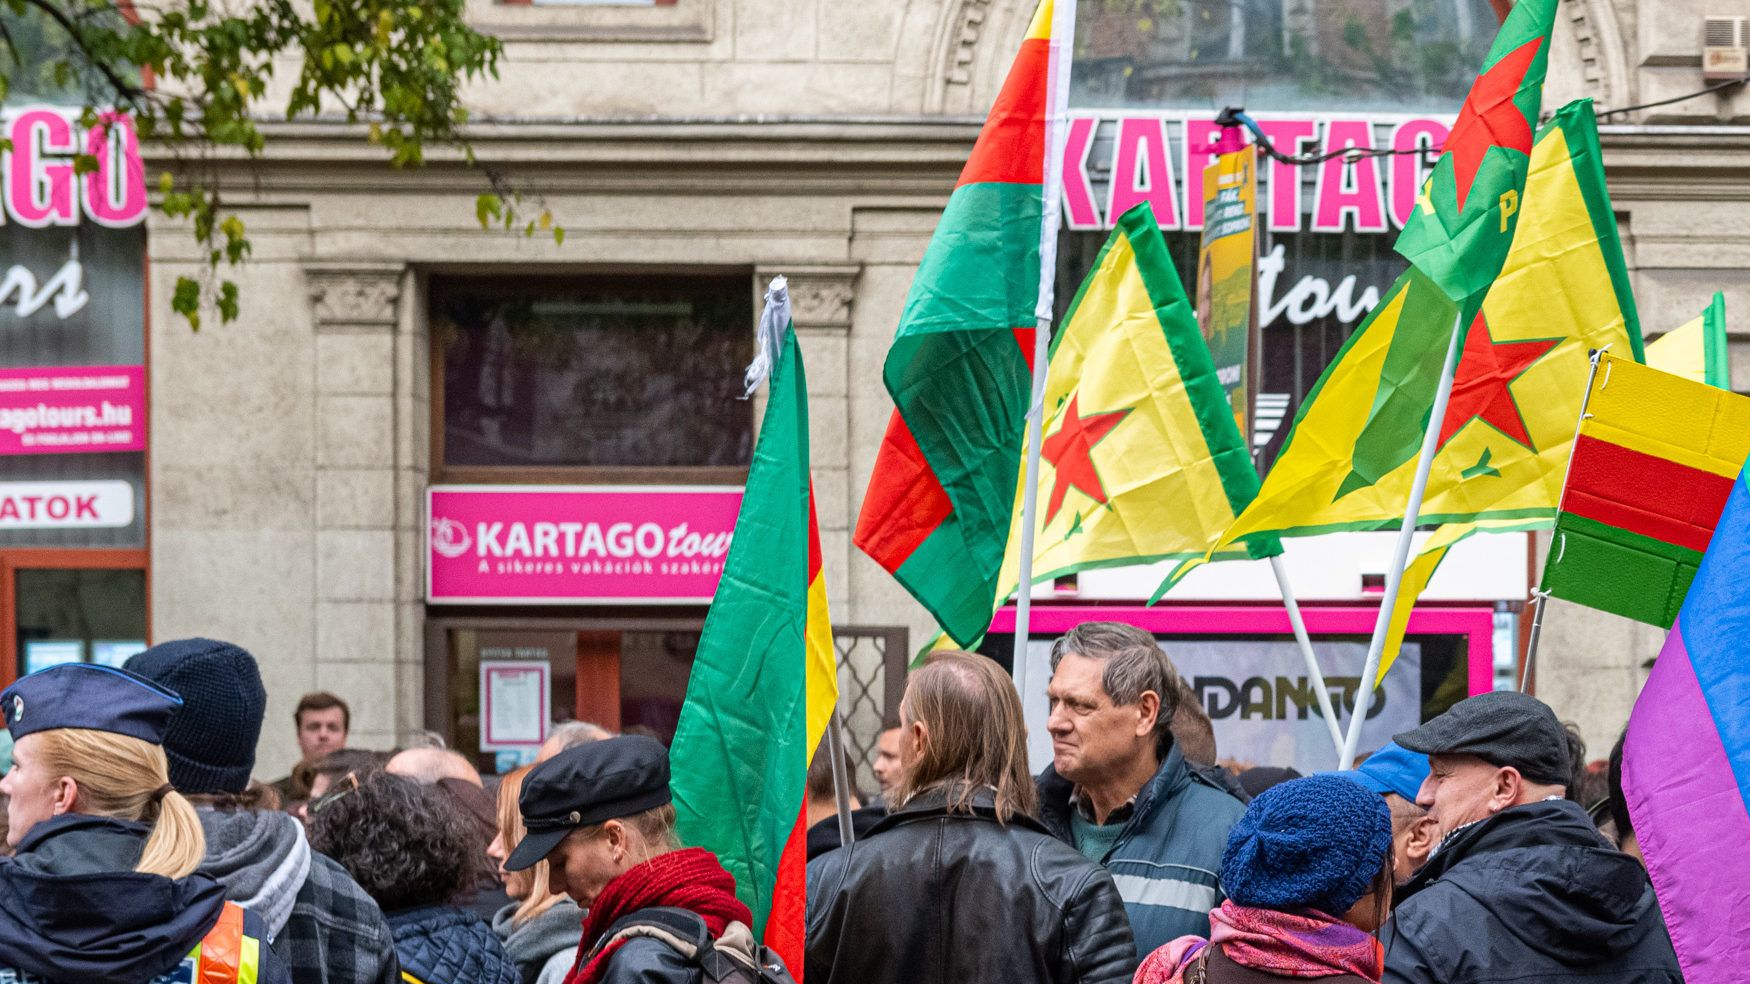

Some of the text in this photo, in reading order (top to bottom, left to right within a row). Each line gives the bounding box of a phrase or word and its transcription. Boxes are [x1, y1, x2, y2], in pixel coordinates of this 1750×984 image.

[1499, 189, 1518, 233] P
[477, 522, 665, 557] KARTAGO
[478, 560, 490, 573] A
[660, 558, 726, 575] szakér
